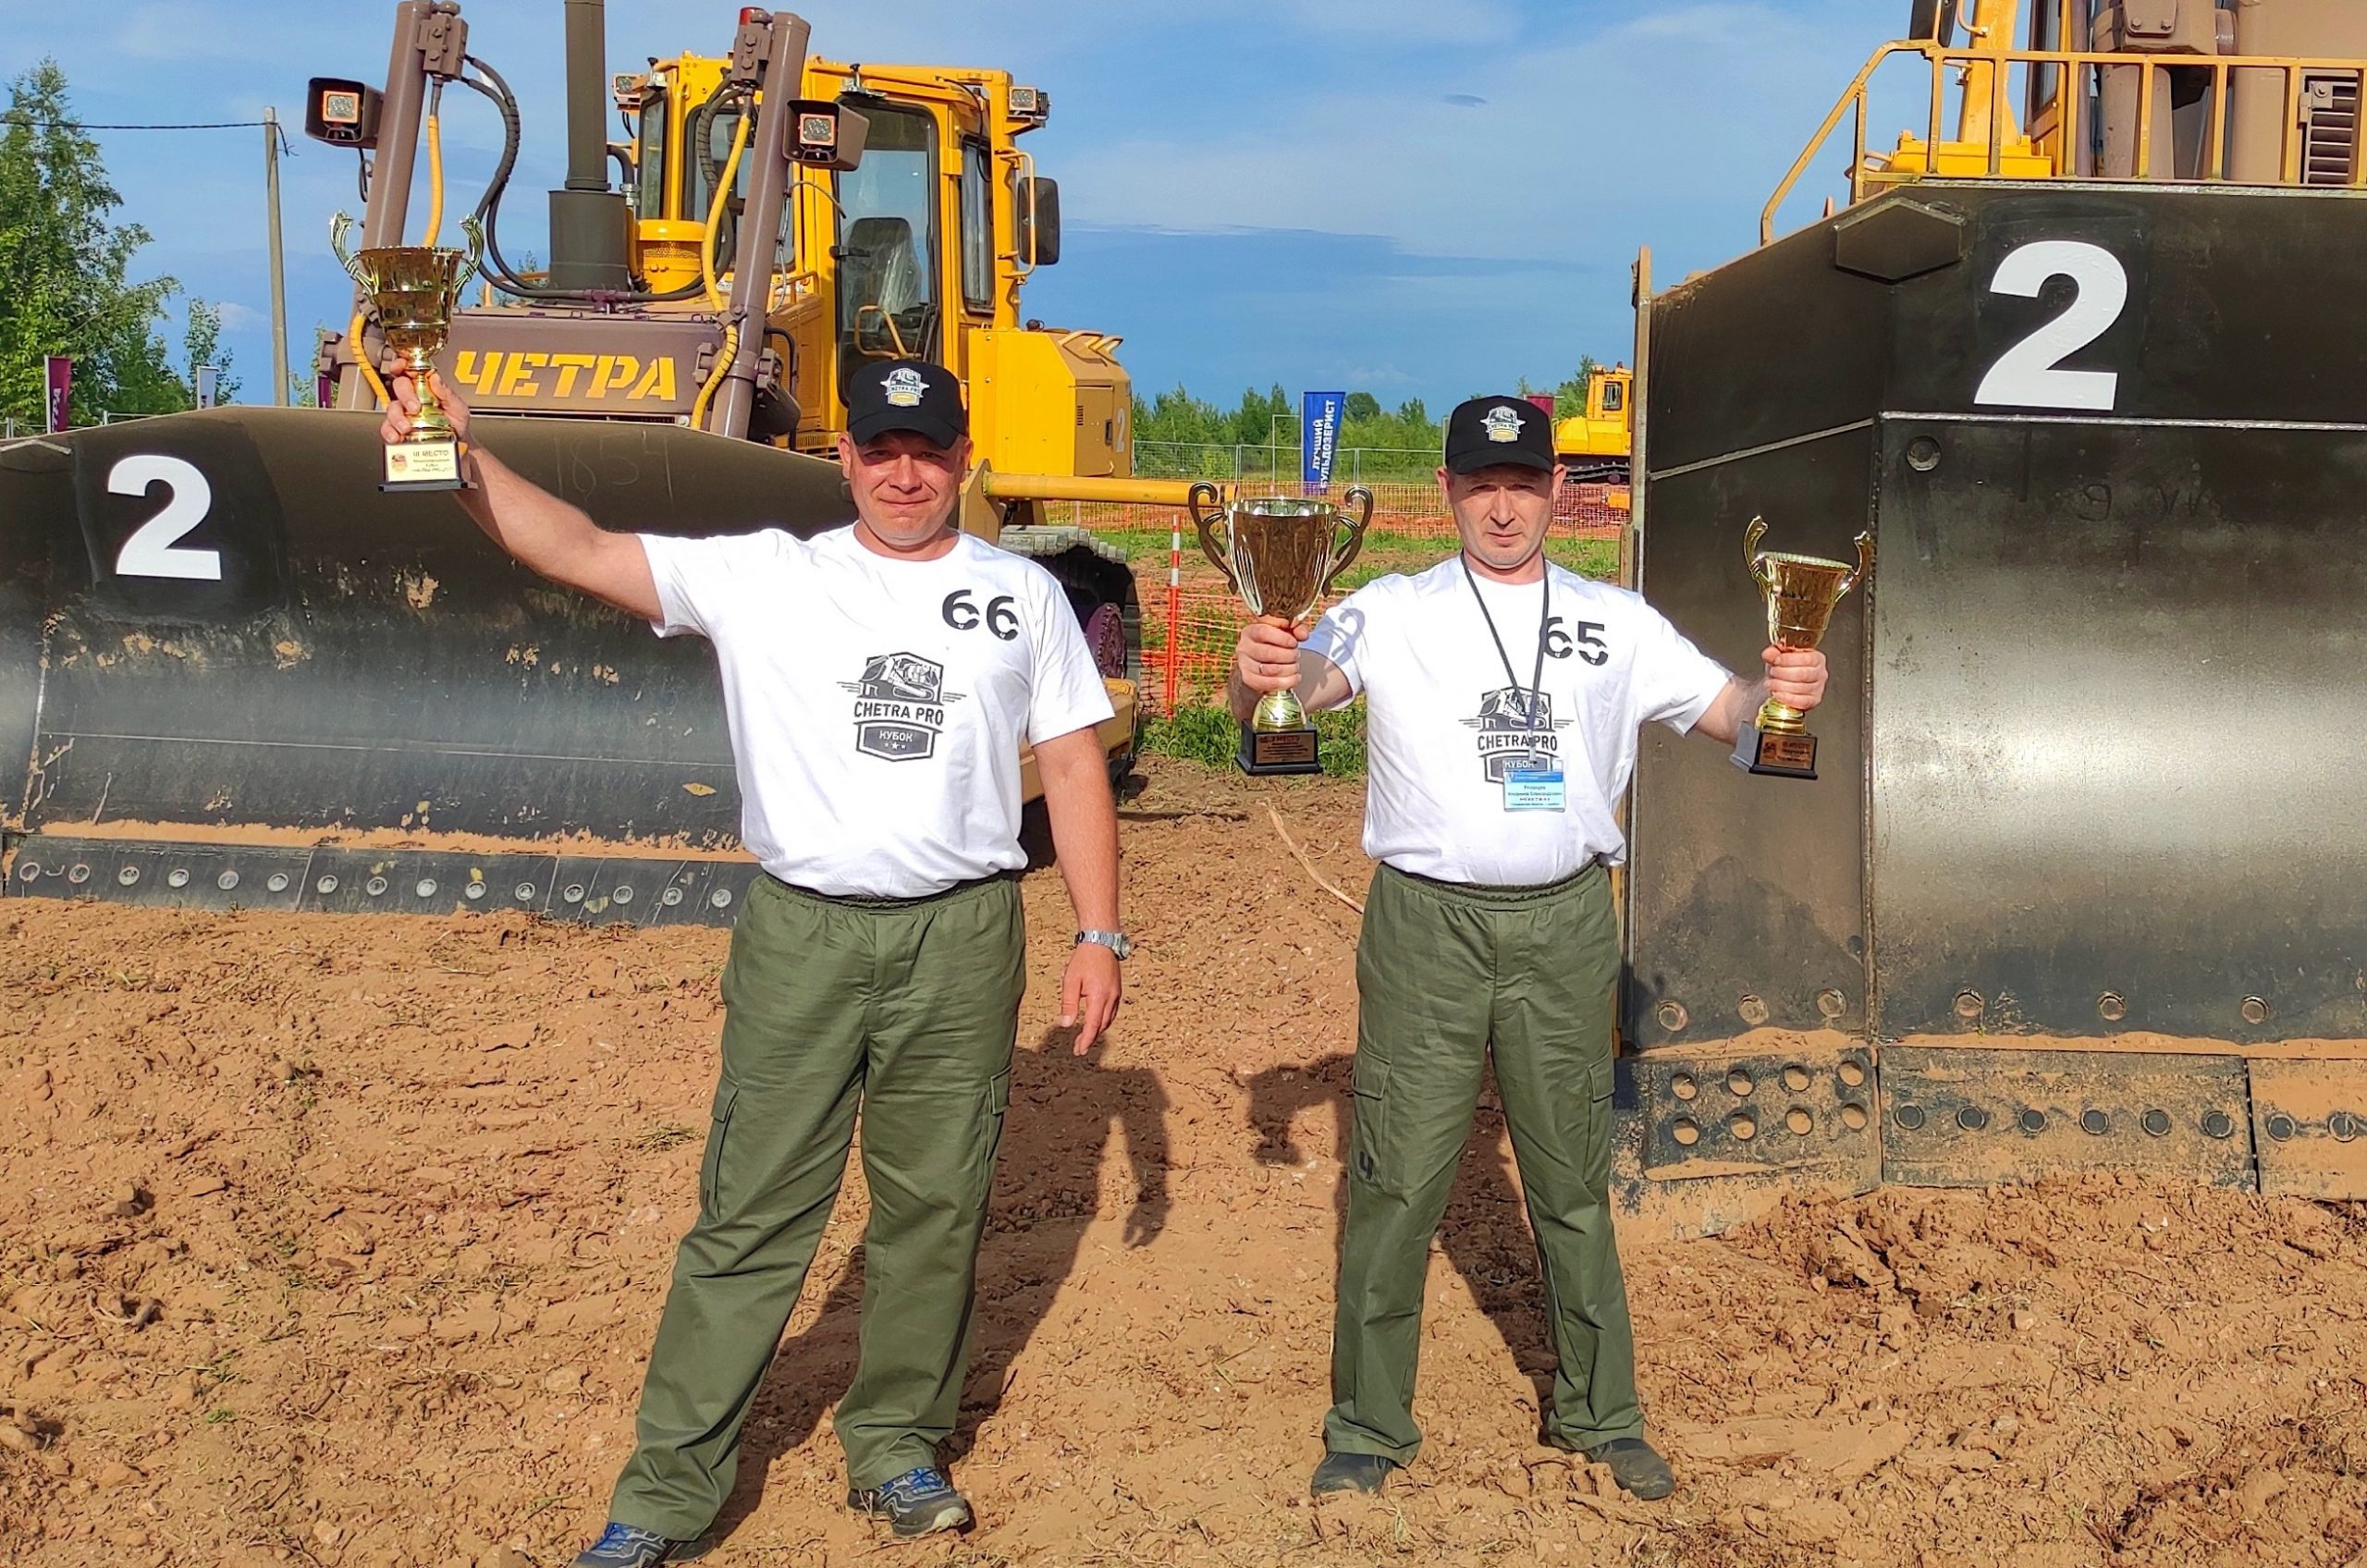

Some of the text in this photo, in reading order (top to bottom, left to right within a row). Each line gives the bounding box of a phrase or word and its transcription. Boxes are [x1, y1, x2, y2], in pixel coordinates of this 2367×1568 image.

[1974, 239, 2128, 410] 2
[454, 350, 677, 400] ЧЕТРА
[1312, 419, 1324, 471] ЛУЧШИЙ
[1319, 399, 1335, 488] БУЛЬДОЗЕРИСТ
[108, 455, 221, 580] 2
[942, 589, 1019, 641] 66
[1542, 617, 1609, 666] 65
[853, 701, 944, 726] CHETRA PRO
[879, 729, 913, 742] КУБОК
[1478, 734, 1557, 751] CHETRA PRO
